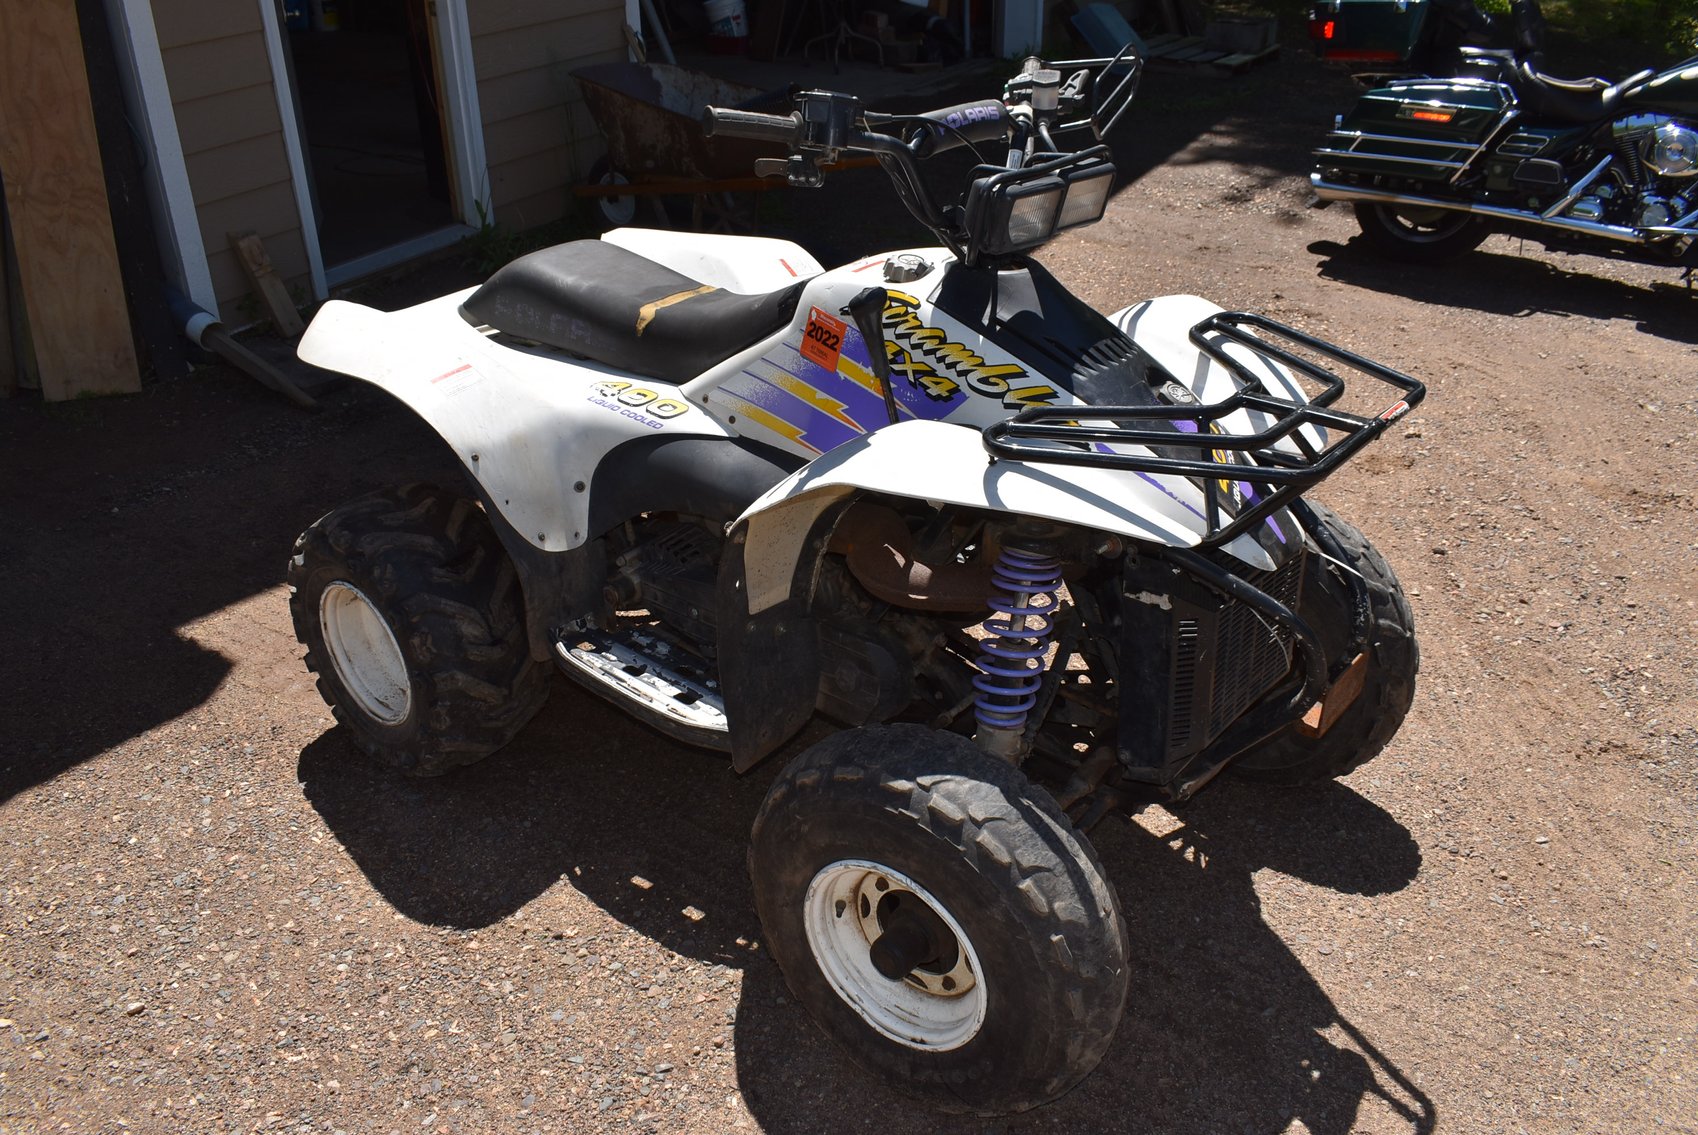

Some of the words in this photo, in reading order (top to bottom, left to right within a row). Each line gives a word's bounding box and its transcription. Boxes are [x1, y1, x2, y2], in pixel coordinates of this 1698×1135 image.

[806, 321, 840, 352] 2022
[587, 396, 621, 412] LIQUID
[619, 409, 664, 430] COOLED
[590, 381, 689, 419] 400
